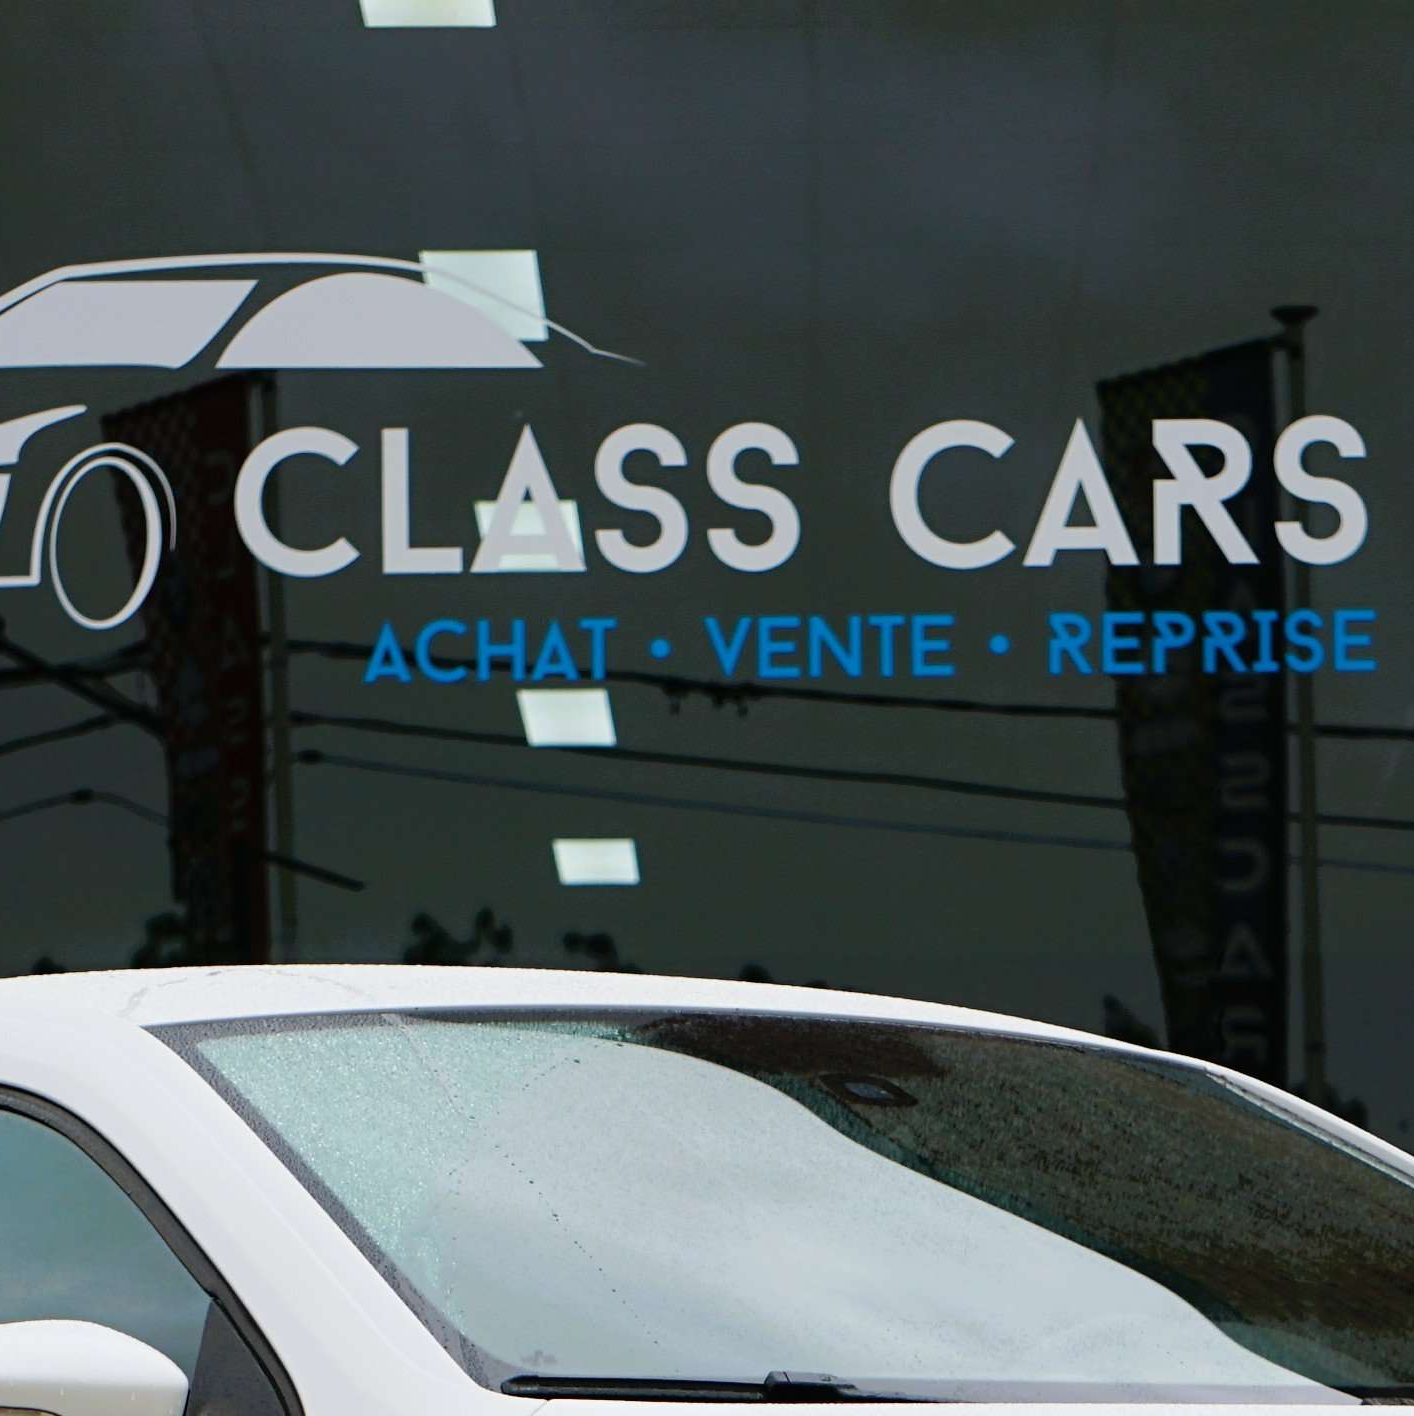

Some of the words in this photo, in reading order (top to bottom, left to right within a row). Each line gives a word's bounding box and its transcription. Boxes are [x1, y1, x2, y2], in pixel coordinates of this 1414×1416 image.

[234, 422, 801, 577] CLASS
[889, 414, 1368, 569] CARS
[363, 617, 617, 683] ACHAT
[704, 614, 955, 679] VENTE
[1048, 609, 1378, 675] REPRISE
